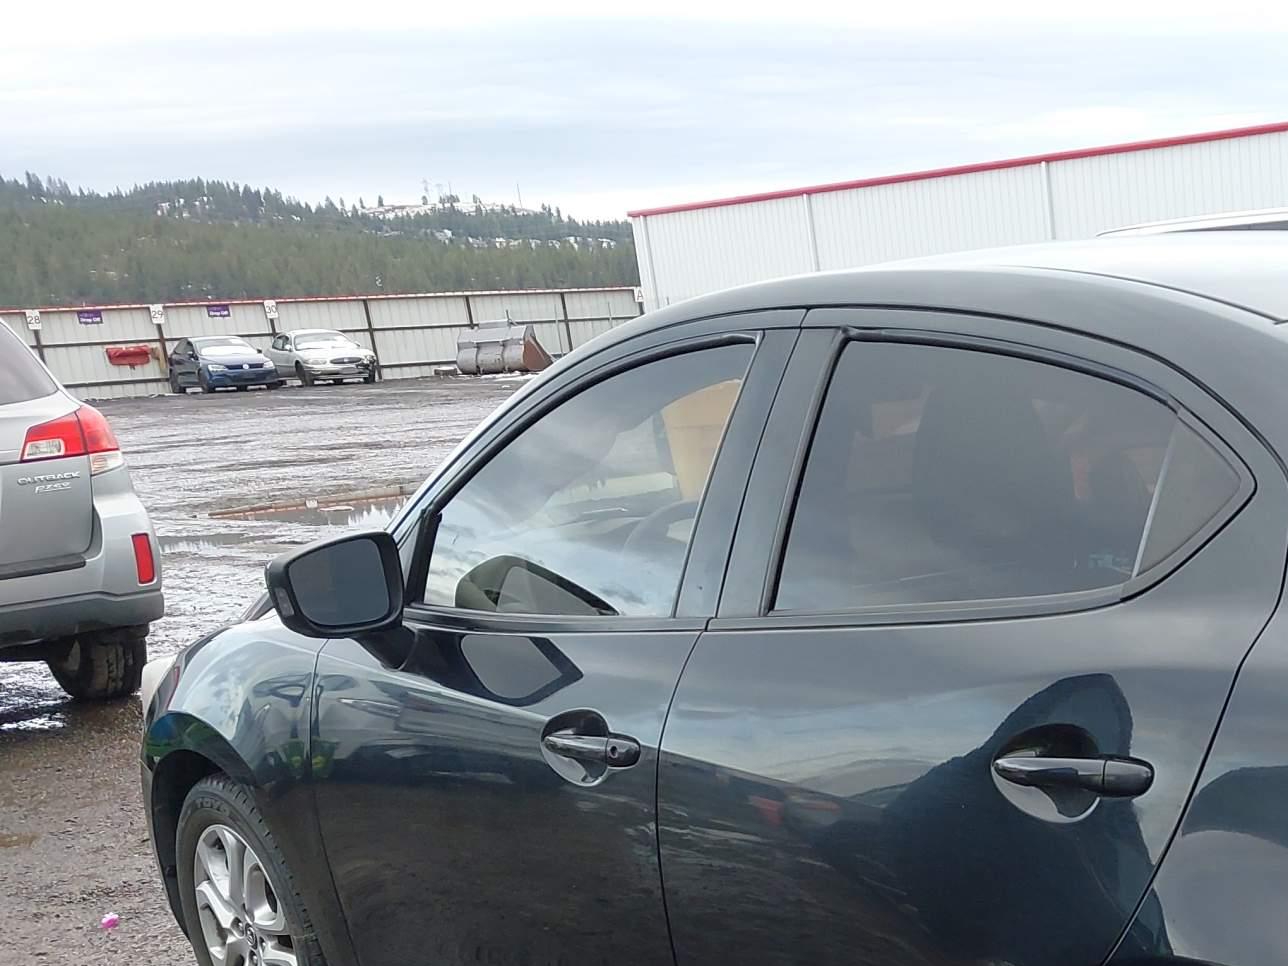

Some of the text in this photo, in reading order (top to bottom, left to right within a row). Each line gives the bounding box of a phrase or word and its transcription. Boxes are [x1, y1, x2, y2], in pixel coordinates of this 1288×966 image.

[637, 289, 644, 300] A
[265, 304, 277, 313] 30
[151, 310, 163, 319] 29
[27, 315, 41, 325] 28
[17, 471, 80, 485] OUTBACK
